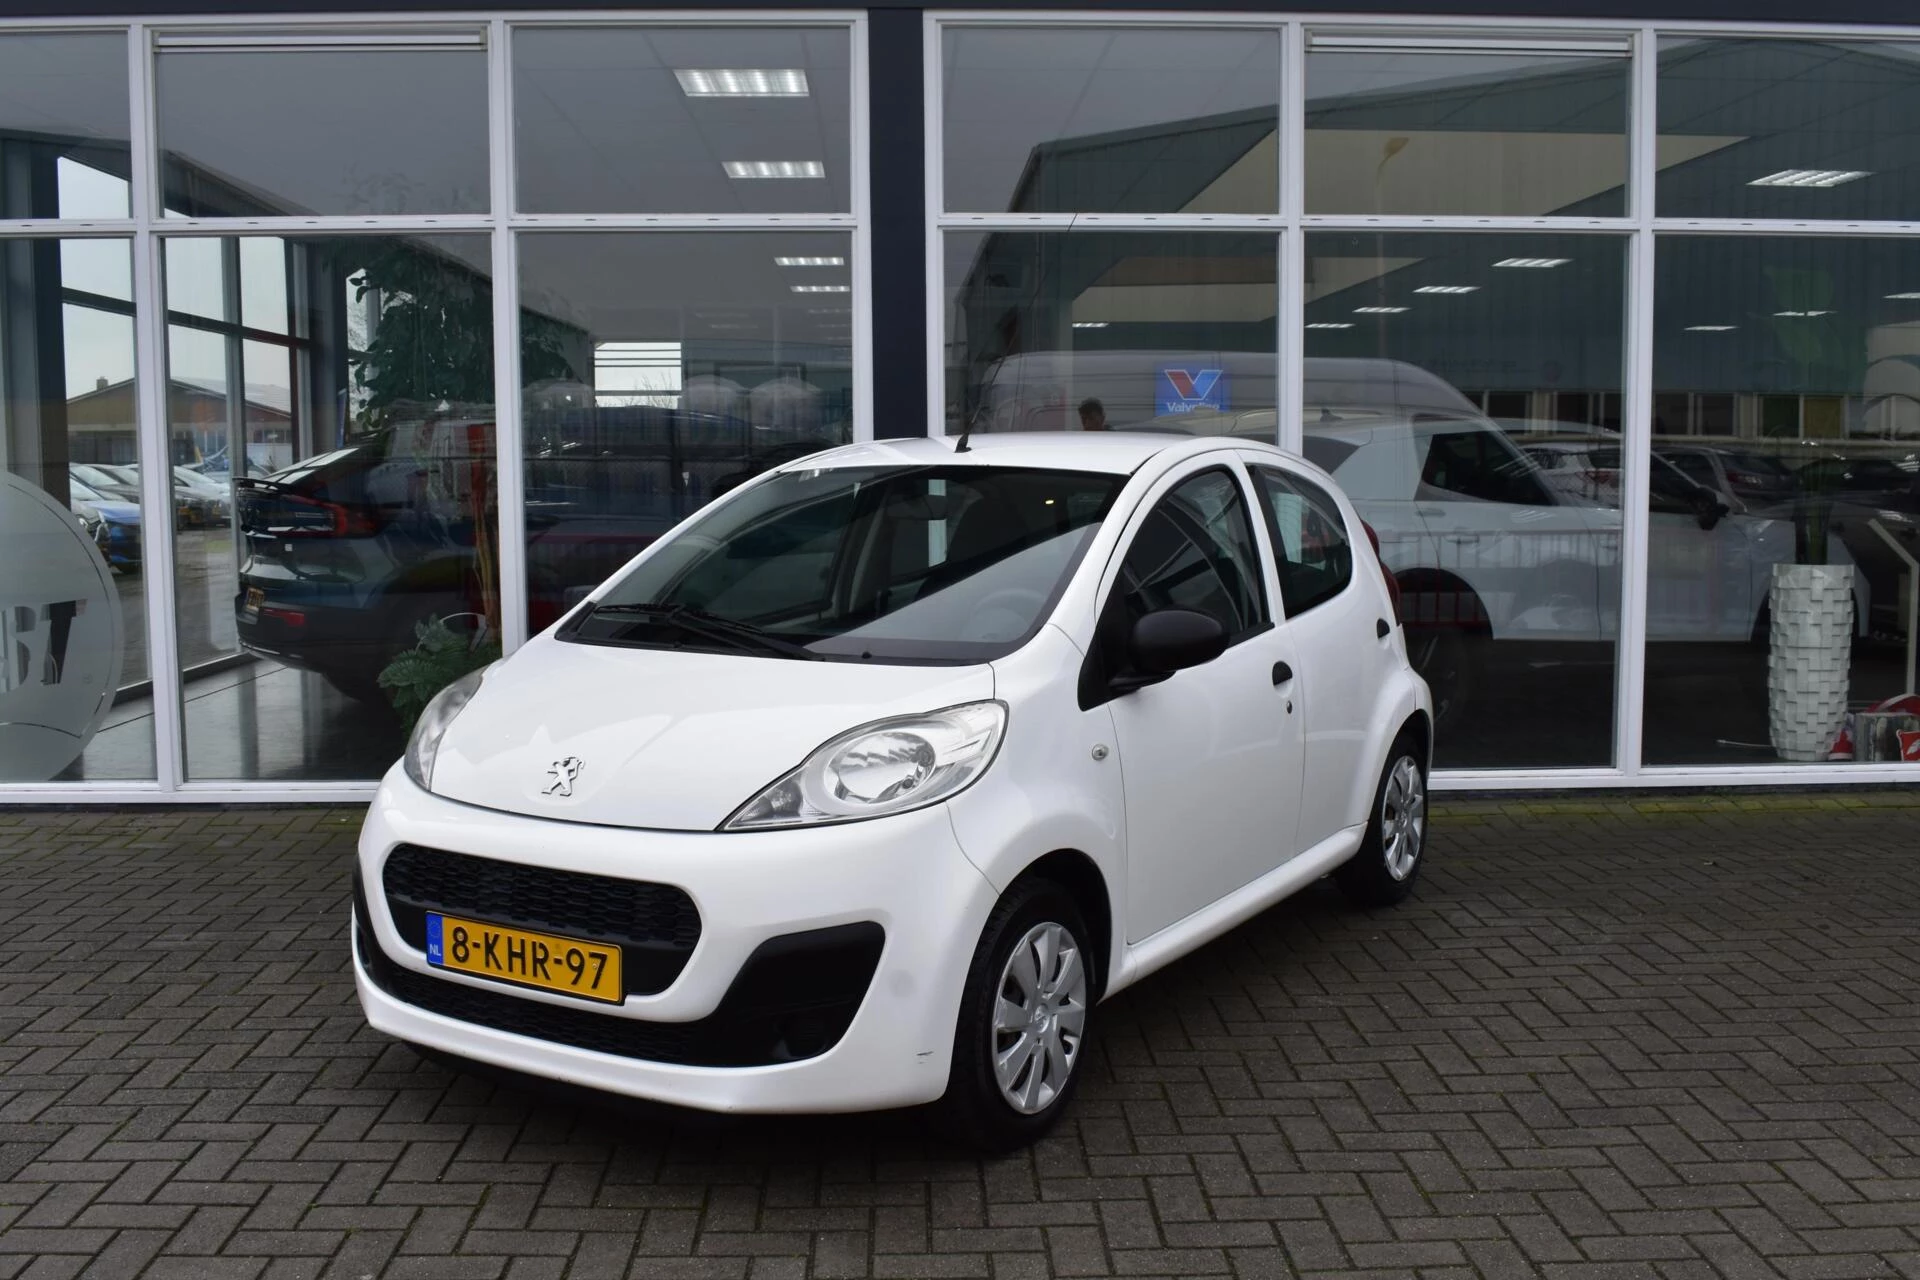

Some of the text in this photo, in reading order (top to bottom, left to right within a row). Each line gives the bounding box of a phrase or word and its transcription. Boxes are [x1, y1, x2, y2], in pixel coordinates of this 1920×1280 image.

[1167, 402, 1220, 413] Valve
[429, 943, 442, 957] NL
[452, 926, 608, 990] 8-KHR-97
